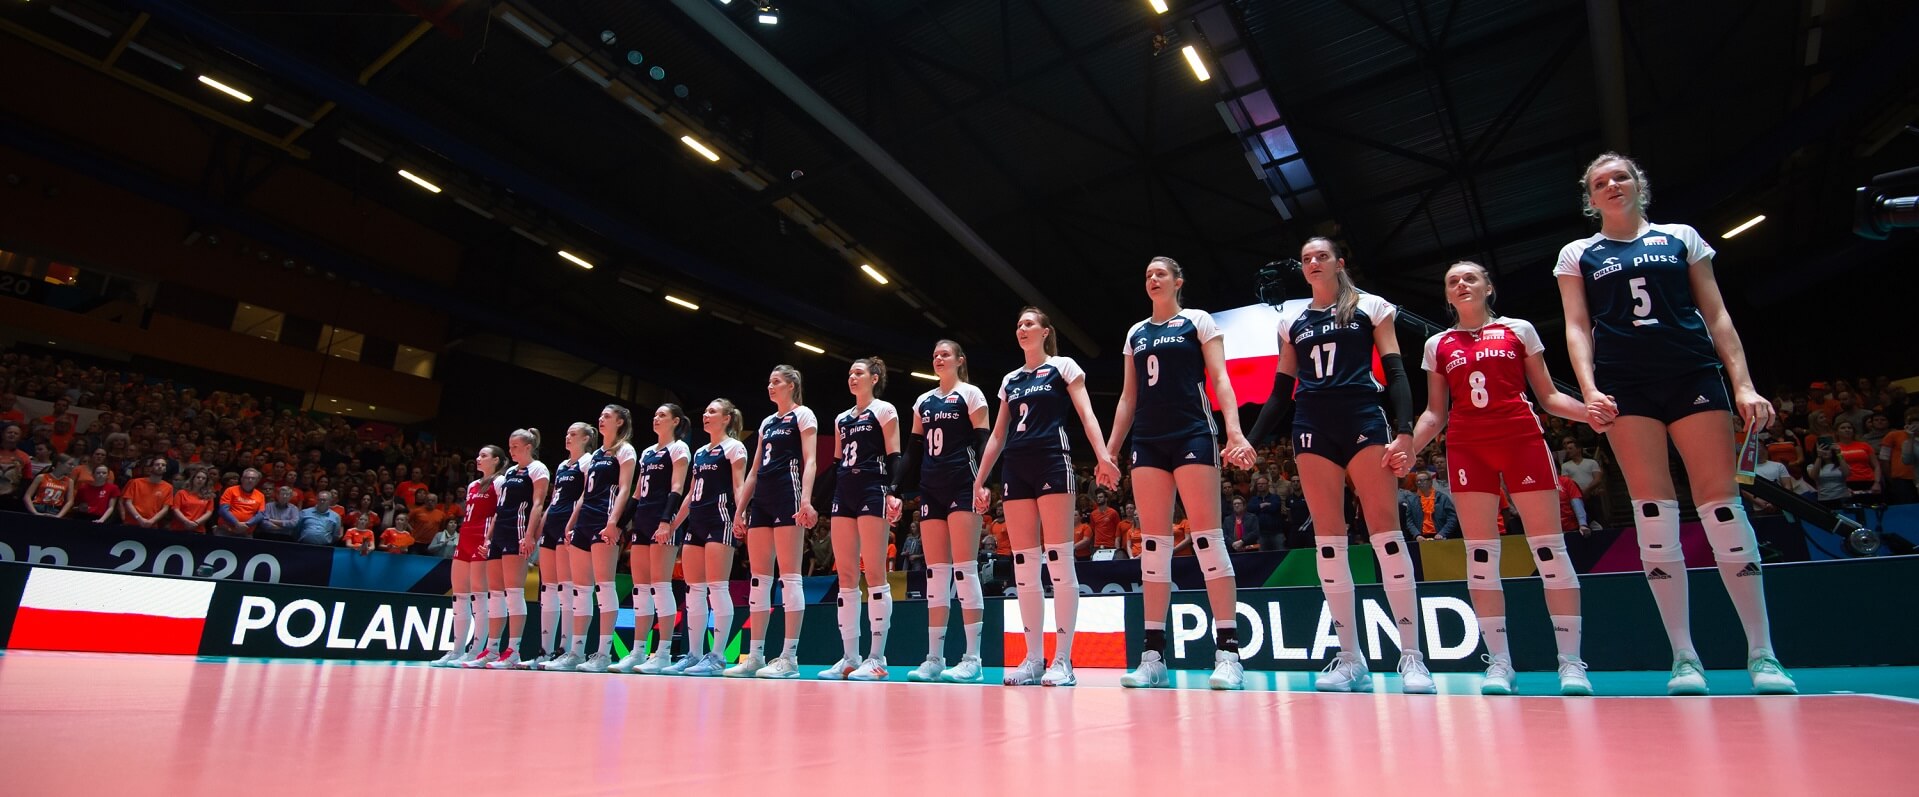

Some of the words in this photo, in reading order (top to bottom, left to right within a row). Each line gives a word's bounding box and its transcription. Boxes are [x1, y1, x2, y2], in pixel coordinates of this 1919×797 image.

[1633, 253, 1668, 267] plus
[1594, 264, 1620, 278] ORLEN
[1629, 277, 1652, 318] 5
[1153, 336, 1176, 347] plus
[1310, 342, 1337, 379] 17
[1475, 348, 1506, 361] plus
[1146, 354, 1160, 387] 9
[1024, 385, 1043, 396] plus
[1469, 370, 1489, 409] 8
[934, 410, 952, 421] plus
[1016, 402, 1029, 432] 2
[771, 429, 785, 438] plus
[849, 425, 865, 436] plus
[926, 427, 943, 457] 19
[1299, 433, 1312, 448] 17
[763, 442, 773, 466] 3
[842, 440, 858, 467] 13
[646, 464, 658, 472] plus
[699, 464, 711, 472] plus
[1458, 468, 1468, 486] 8
[587, 471, 596, 493] 6
[640, 475, 650, 498] 15
[691, 477, 704, 502] 10
[1003, 483, 1009, 497] 2
[920, 504, 929, 517] 19
[232, 595, 477, 651] POLAND
[1172, 594, 1481, 661] POLAND
